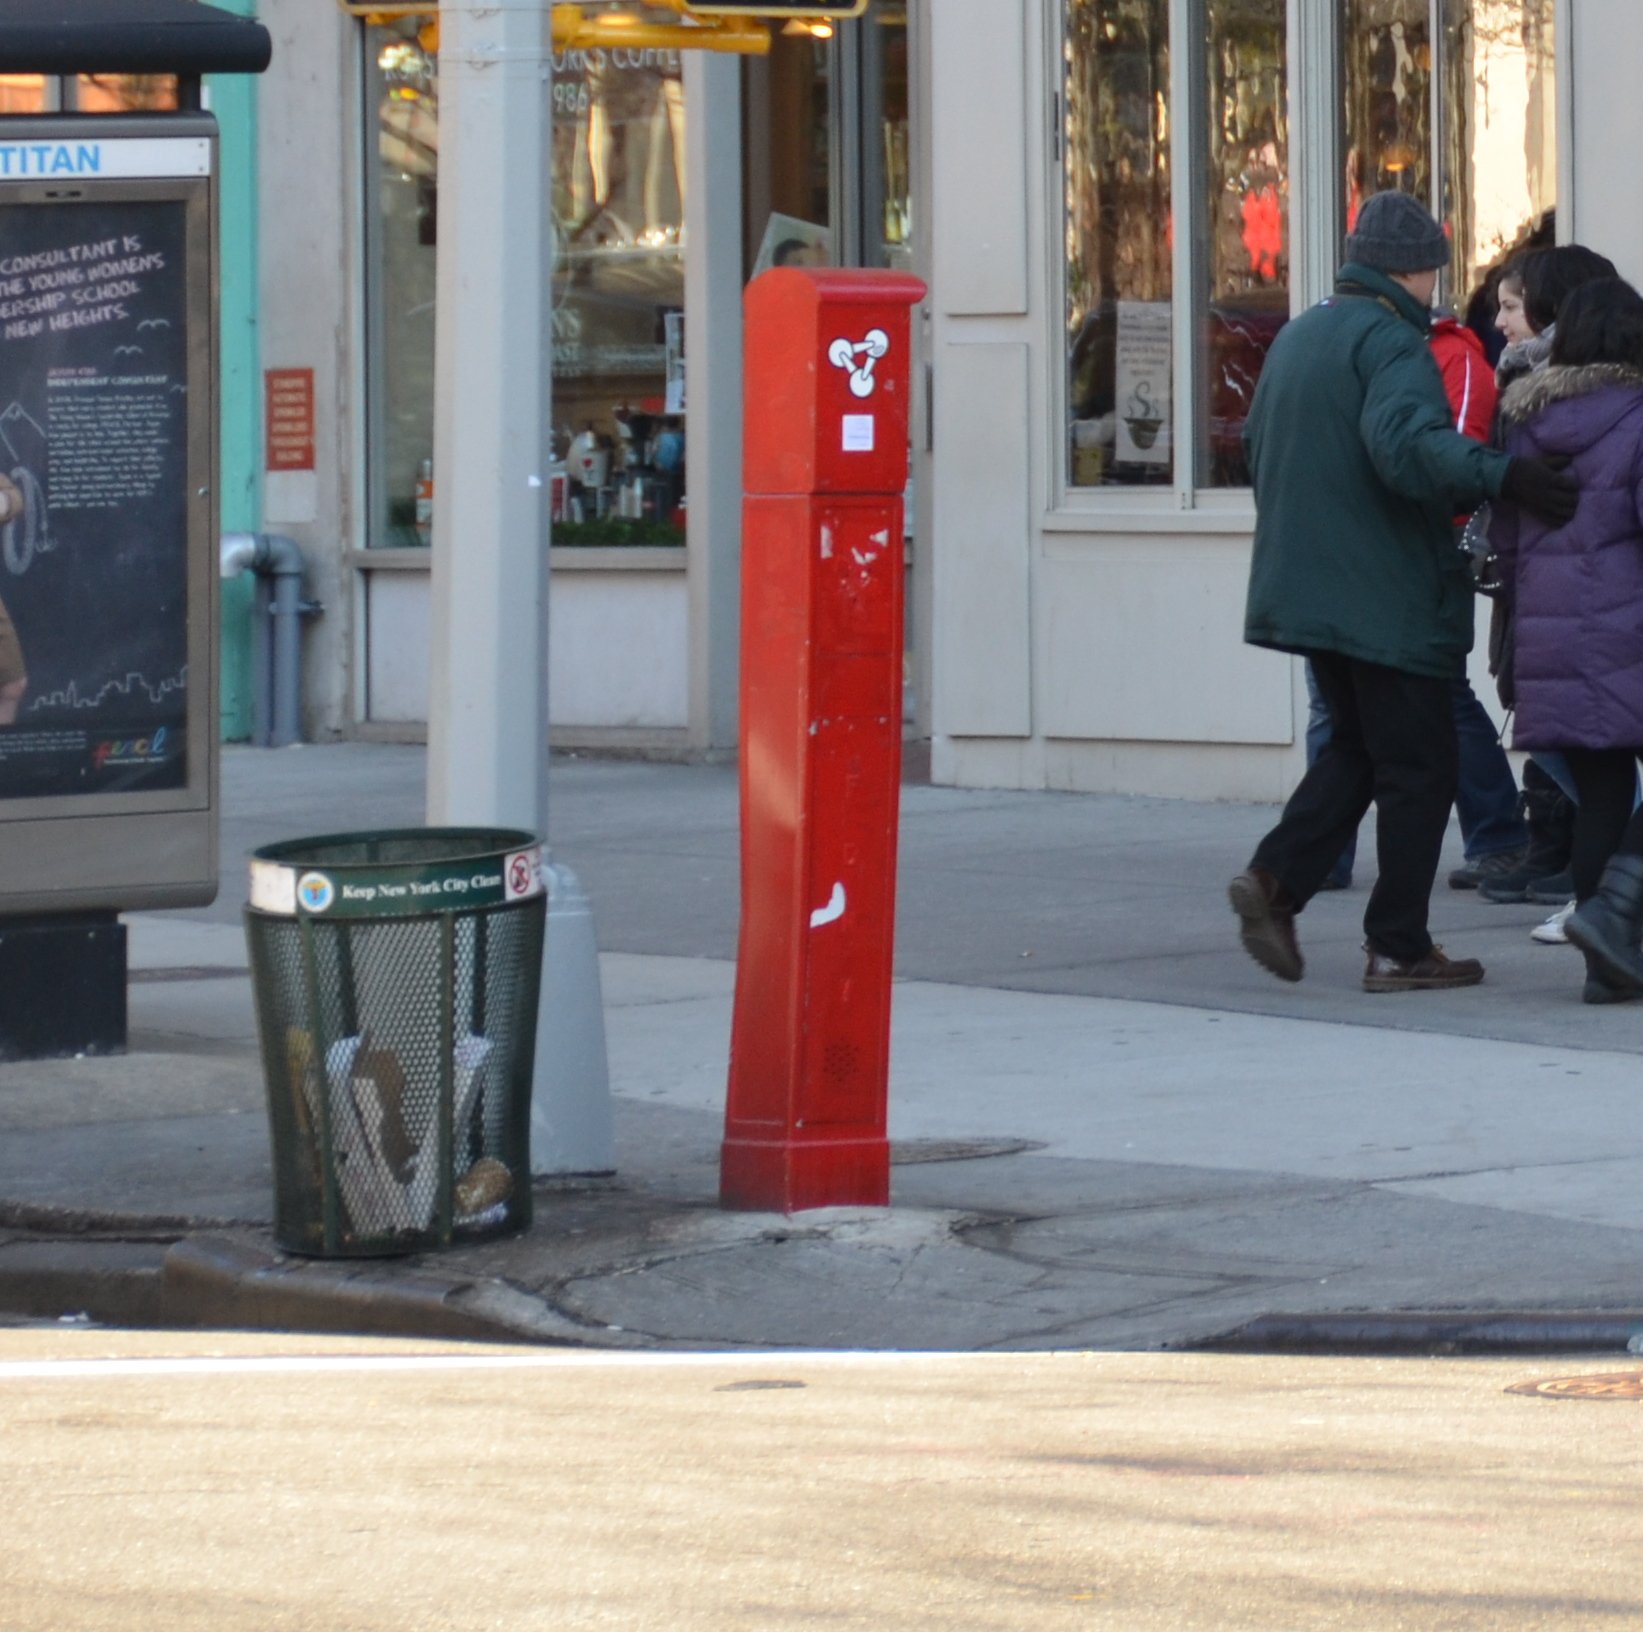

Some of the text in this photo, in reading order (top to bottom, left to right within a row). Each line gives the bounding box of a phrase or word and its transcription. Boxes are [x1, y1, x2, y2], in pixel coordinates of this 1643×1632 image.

[552, 82, 588, 112] 986
[0, 144, 100, 174] TITAN
[2, 234, 142, 275] CONSULTANT IS
[29, 267, 84, 292] YOUNG
[0, 280, 140, 319] ERSHIP SCHOOL
[5, 318, 43, 340] NEW
[342, 884, 375, 901] Keep
[378, 883, 406, 899] New
[408, 881, 441, 898] York
[442, 878, 468, 894] City
